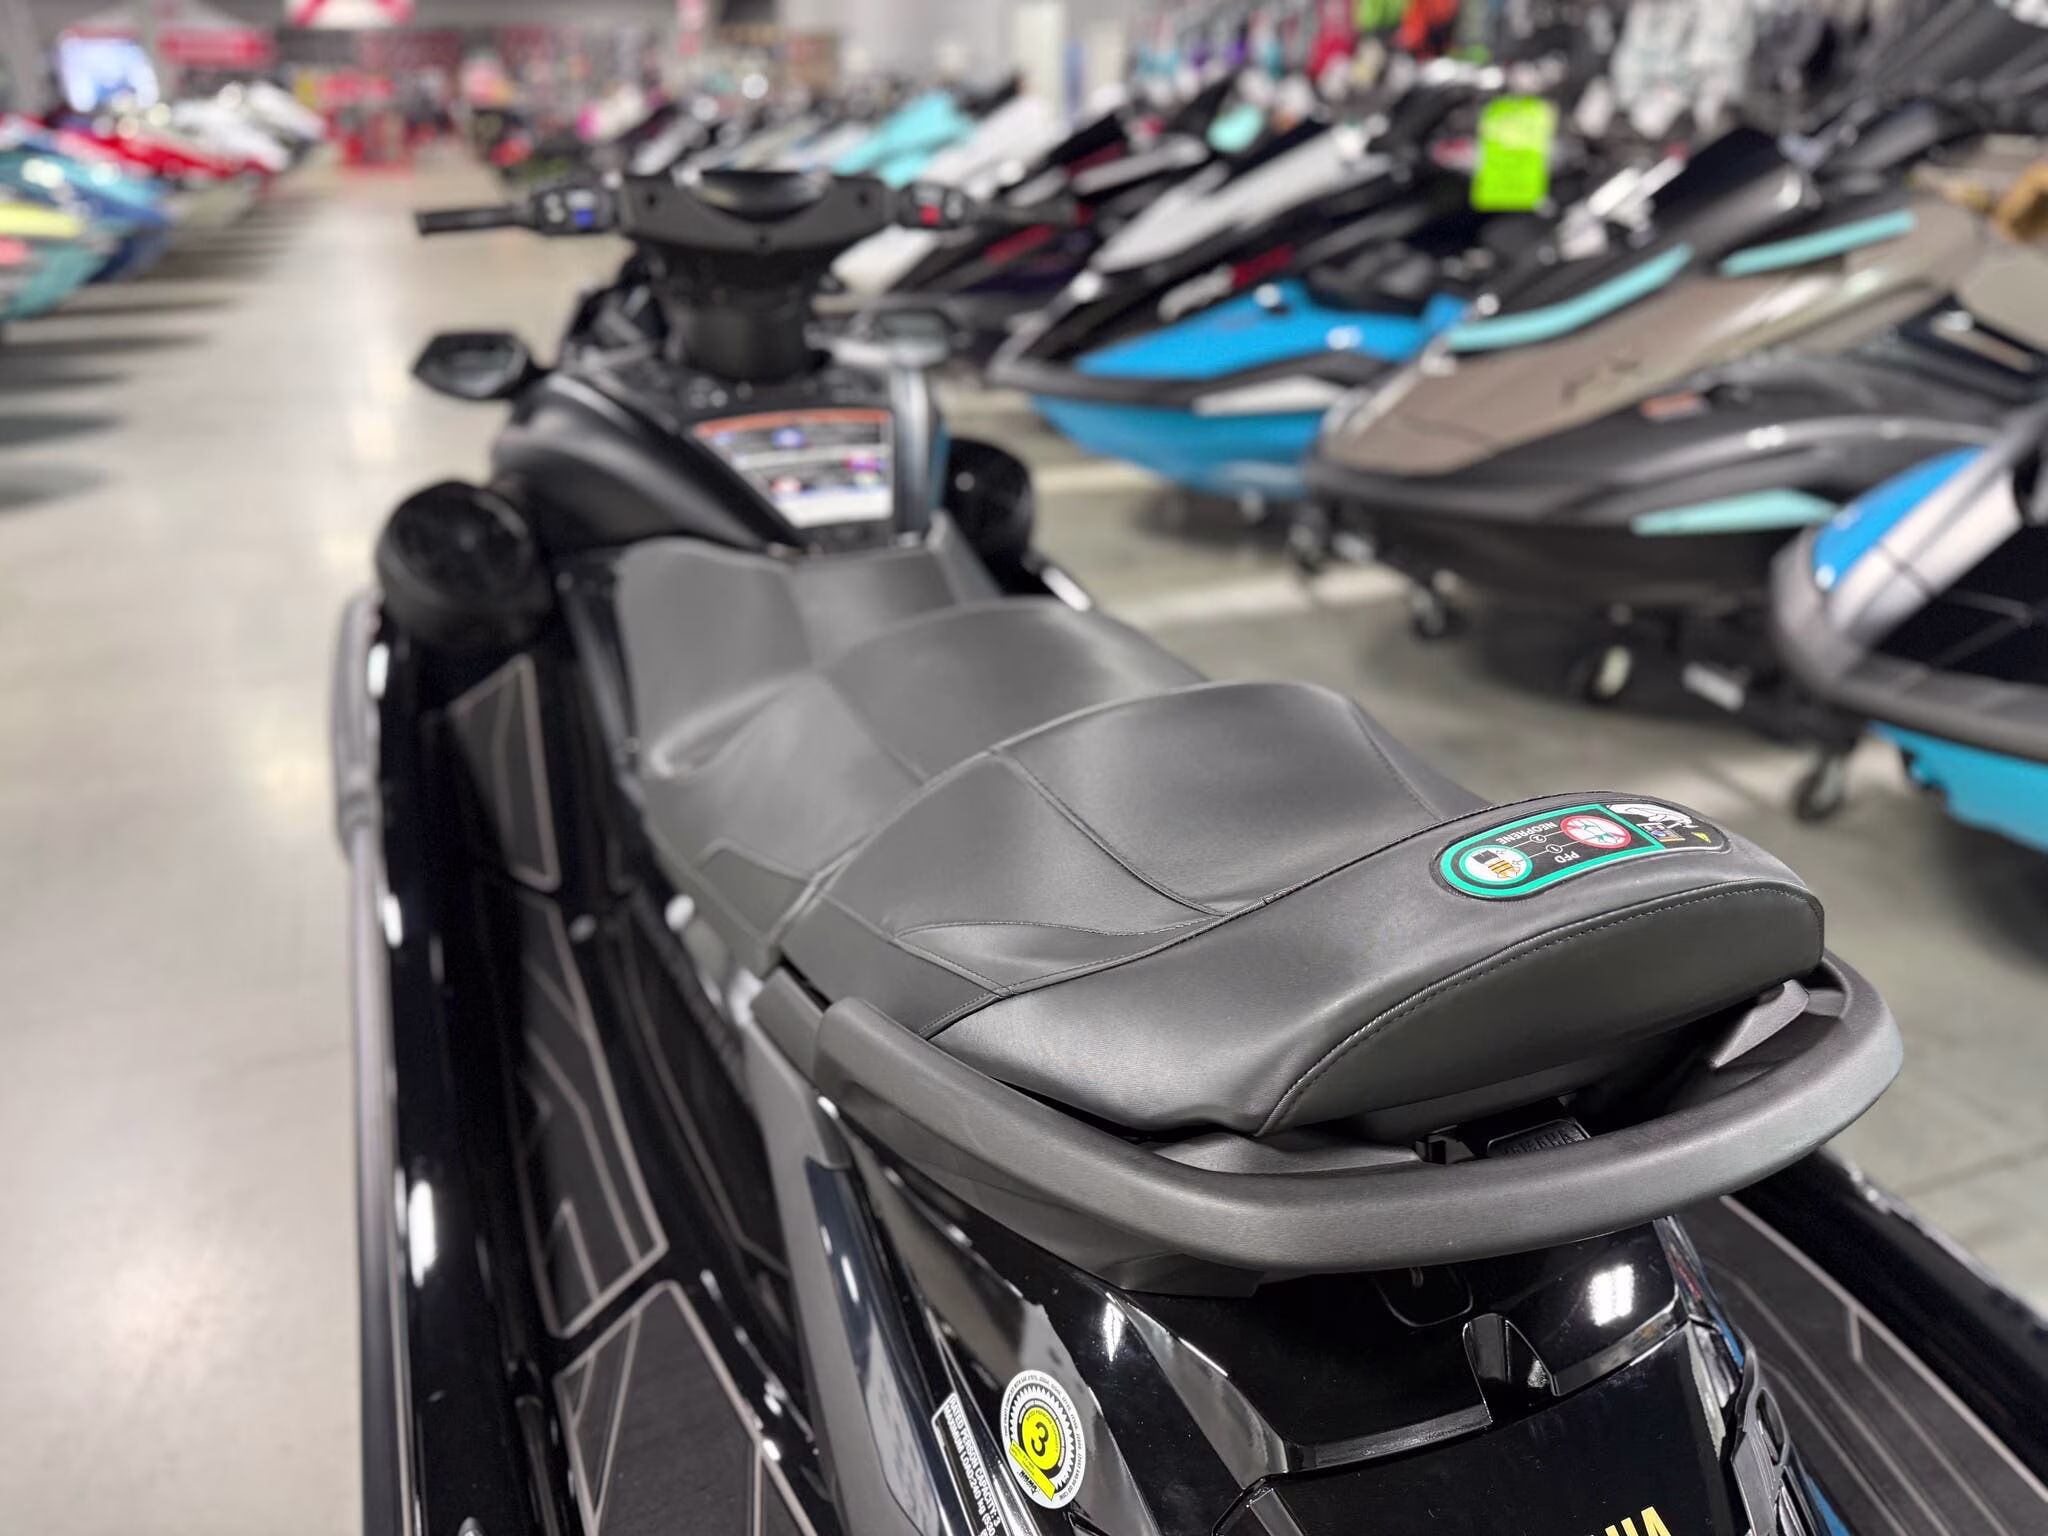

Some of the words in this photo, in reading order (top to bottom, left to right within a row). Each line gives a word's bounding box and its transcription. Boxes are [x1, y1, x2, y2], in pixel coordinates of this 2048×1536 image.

[1495, 821, 1558, 845] NEOPRENE
[1554, 850, 1580, 863] PFD
[1031, 1421, 1049, 1457] 3
[944, 1404, 965, 1454] MAXIMUM
[977, 1497, 987, 1515] kg
[950, 1396, 966, 1430] RATED
[960, 1428, 979, 1469] PERSON
[993, 1516, 1000, 1527] 3
